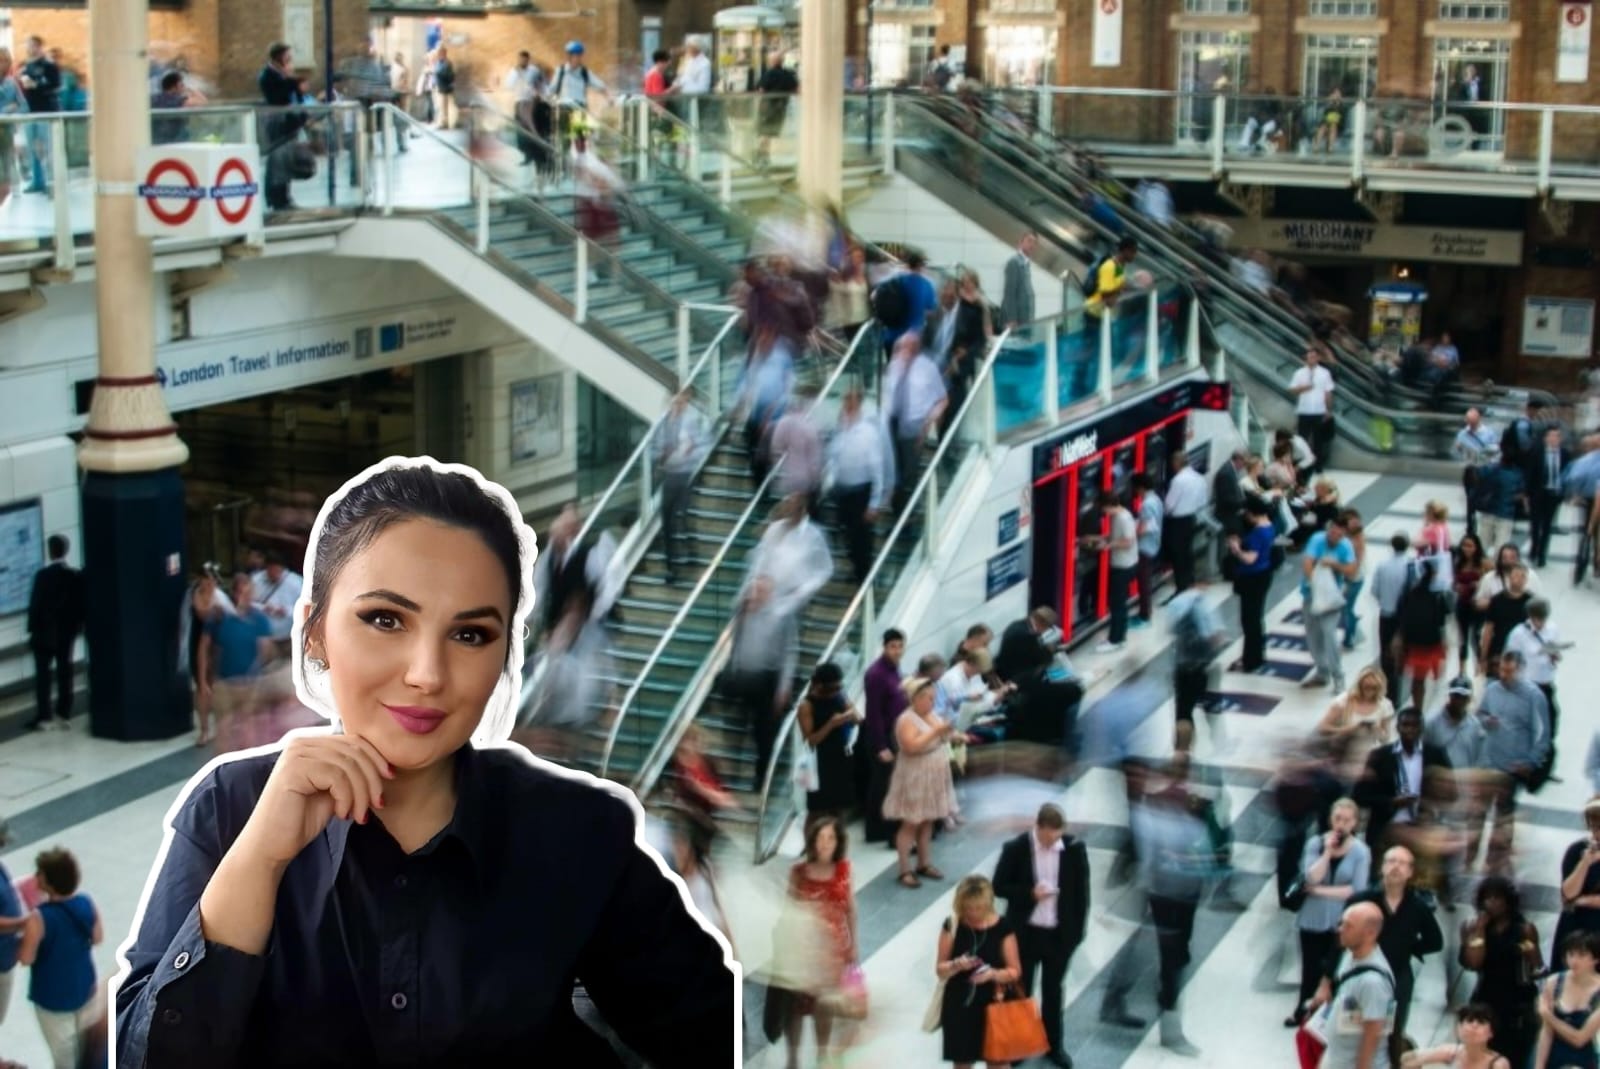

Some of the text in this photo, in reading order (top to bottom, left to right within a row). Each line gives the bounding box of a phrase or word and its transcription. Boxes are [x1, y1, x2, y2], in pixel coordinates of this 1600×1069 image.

[1284, 222, 1375, 243] MERCHANT
[171, 338, 350, 387] London Travel Information
[1062, 429, 1098, 467] NatWest
